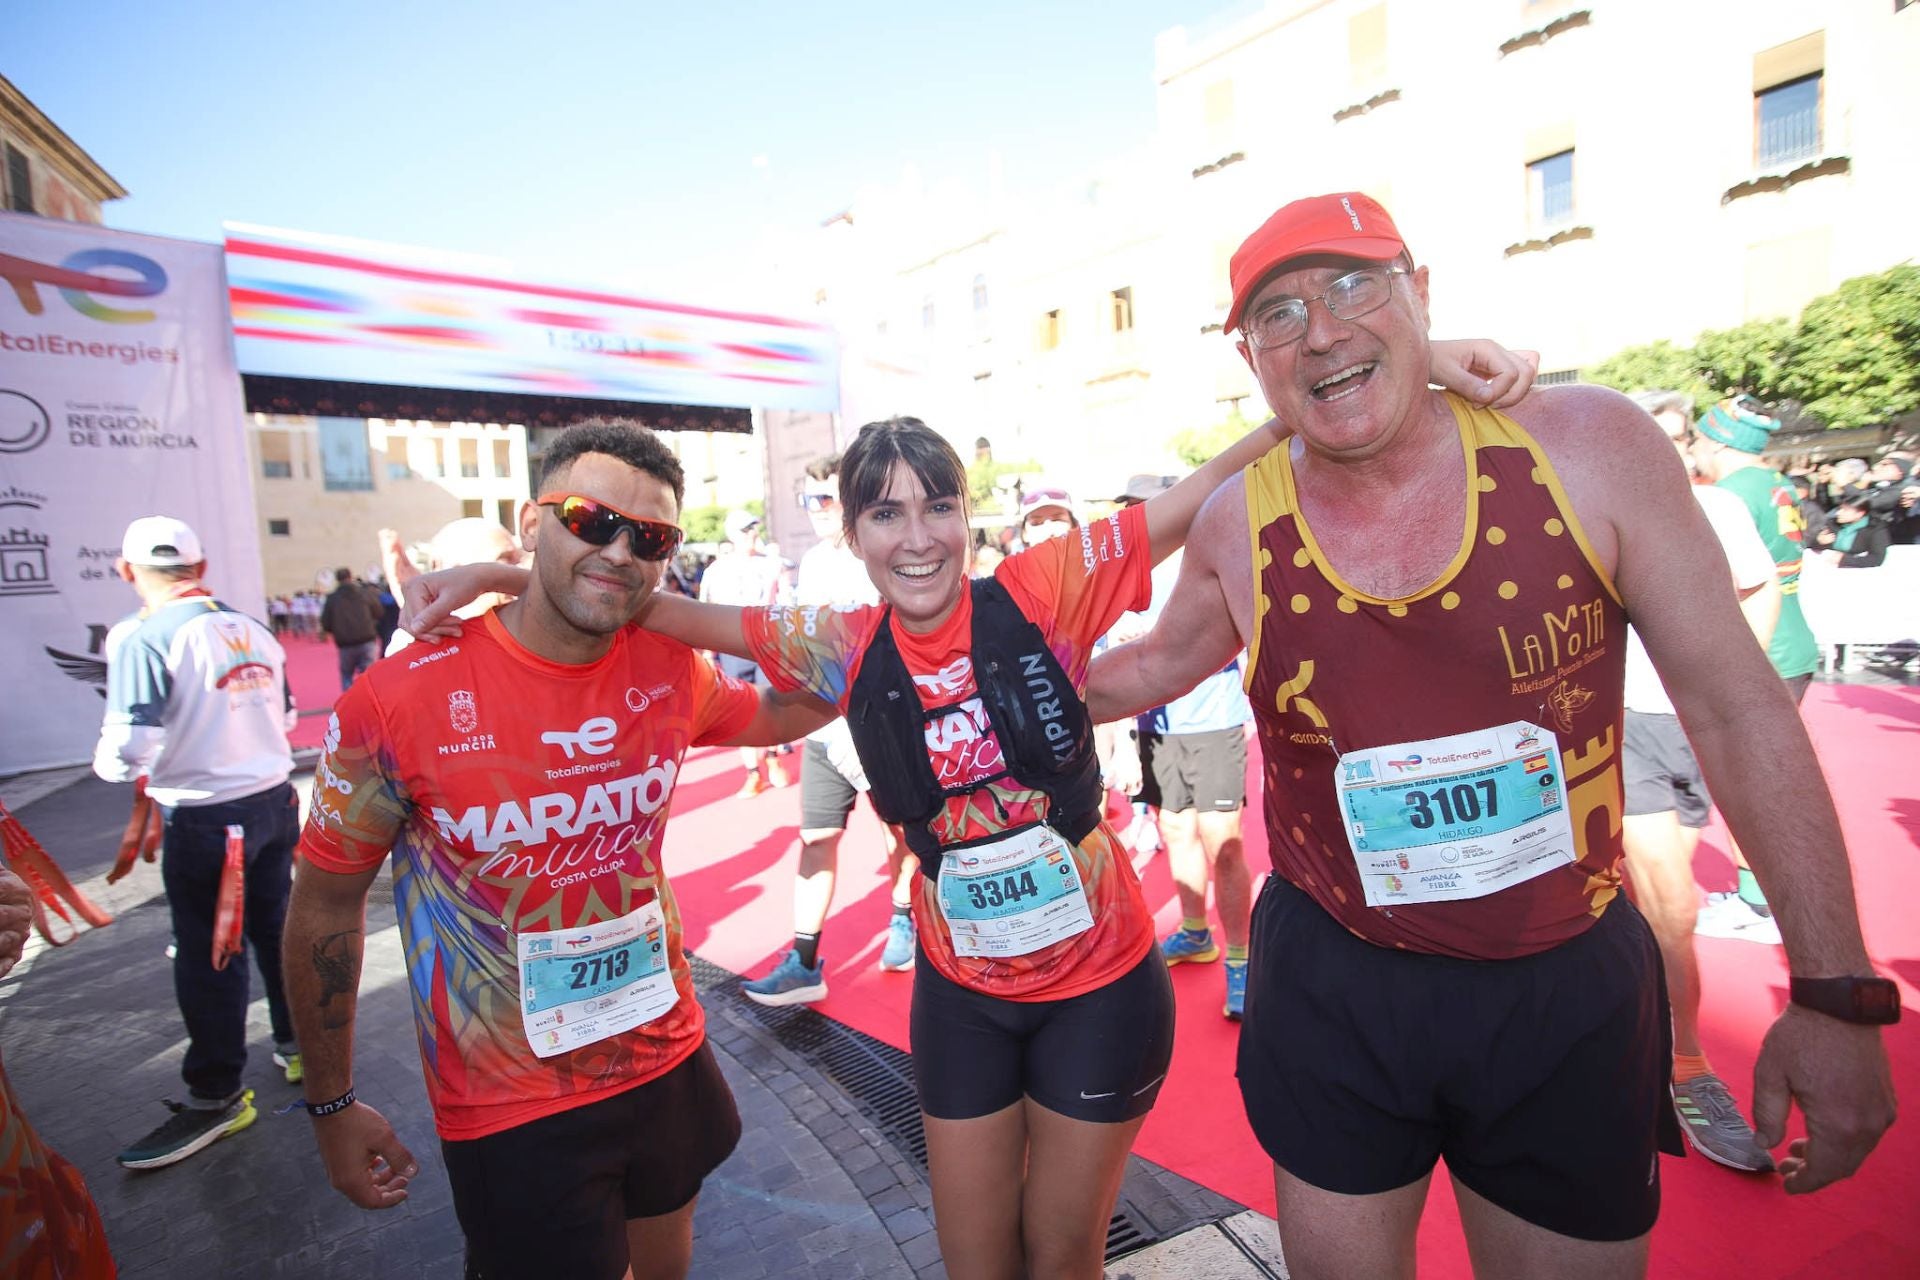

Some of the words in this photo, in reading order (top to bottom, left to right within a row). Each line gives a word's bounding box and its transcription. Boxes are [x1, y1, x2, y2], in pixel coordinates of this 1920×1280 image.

[69, 431, 101, 447] DE
[109, 432, 199, 448] MURCIA
[408, 645, 460, 670] ARGIUS
[1511, 674, 1556, 695] Atletismo
[1019, 652, 1077, 768] KIPRUN
[438, 740, 497, 755] MURCIA
[1426, 747, 1492, 766] TotalEnergies
[544, 758, 622, 780] TotalEnergies
[1404, 778, 1499, 829] 3107
[1437, 825, 1484, 841] HIDALGO
[1511, 827, 1547, 845] ARGIUS
[550, 871, 588, 889] COSTA
[588, 857, 627, 879] CÁLIDA
[1419, 871, 1463, 884] AVANZA
[967, 870, 1039, 910] 3344
[1428, 881, 1458, 890] FIBRA
[570, 949, 630, 990] 2713
